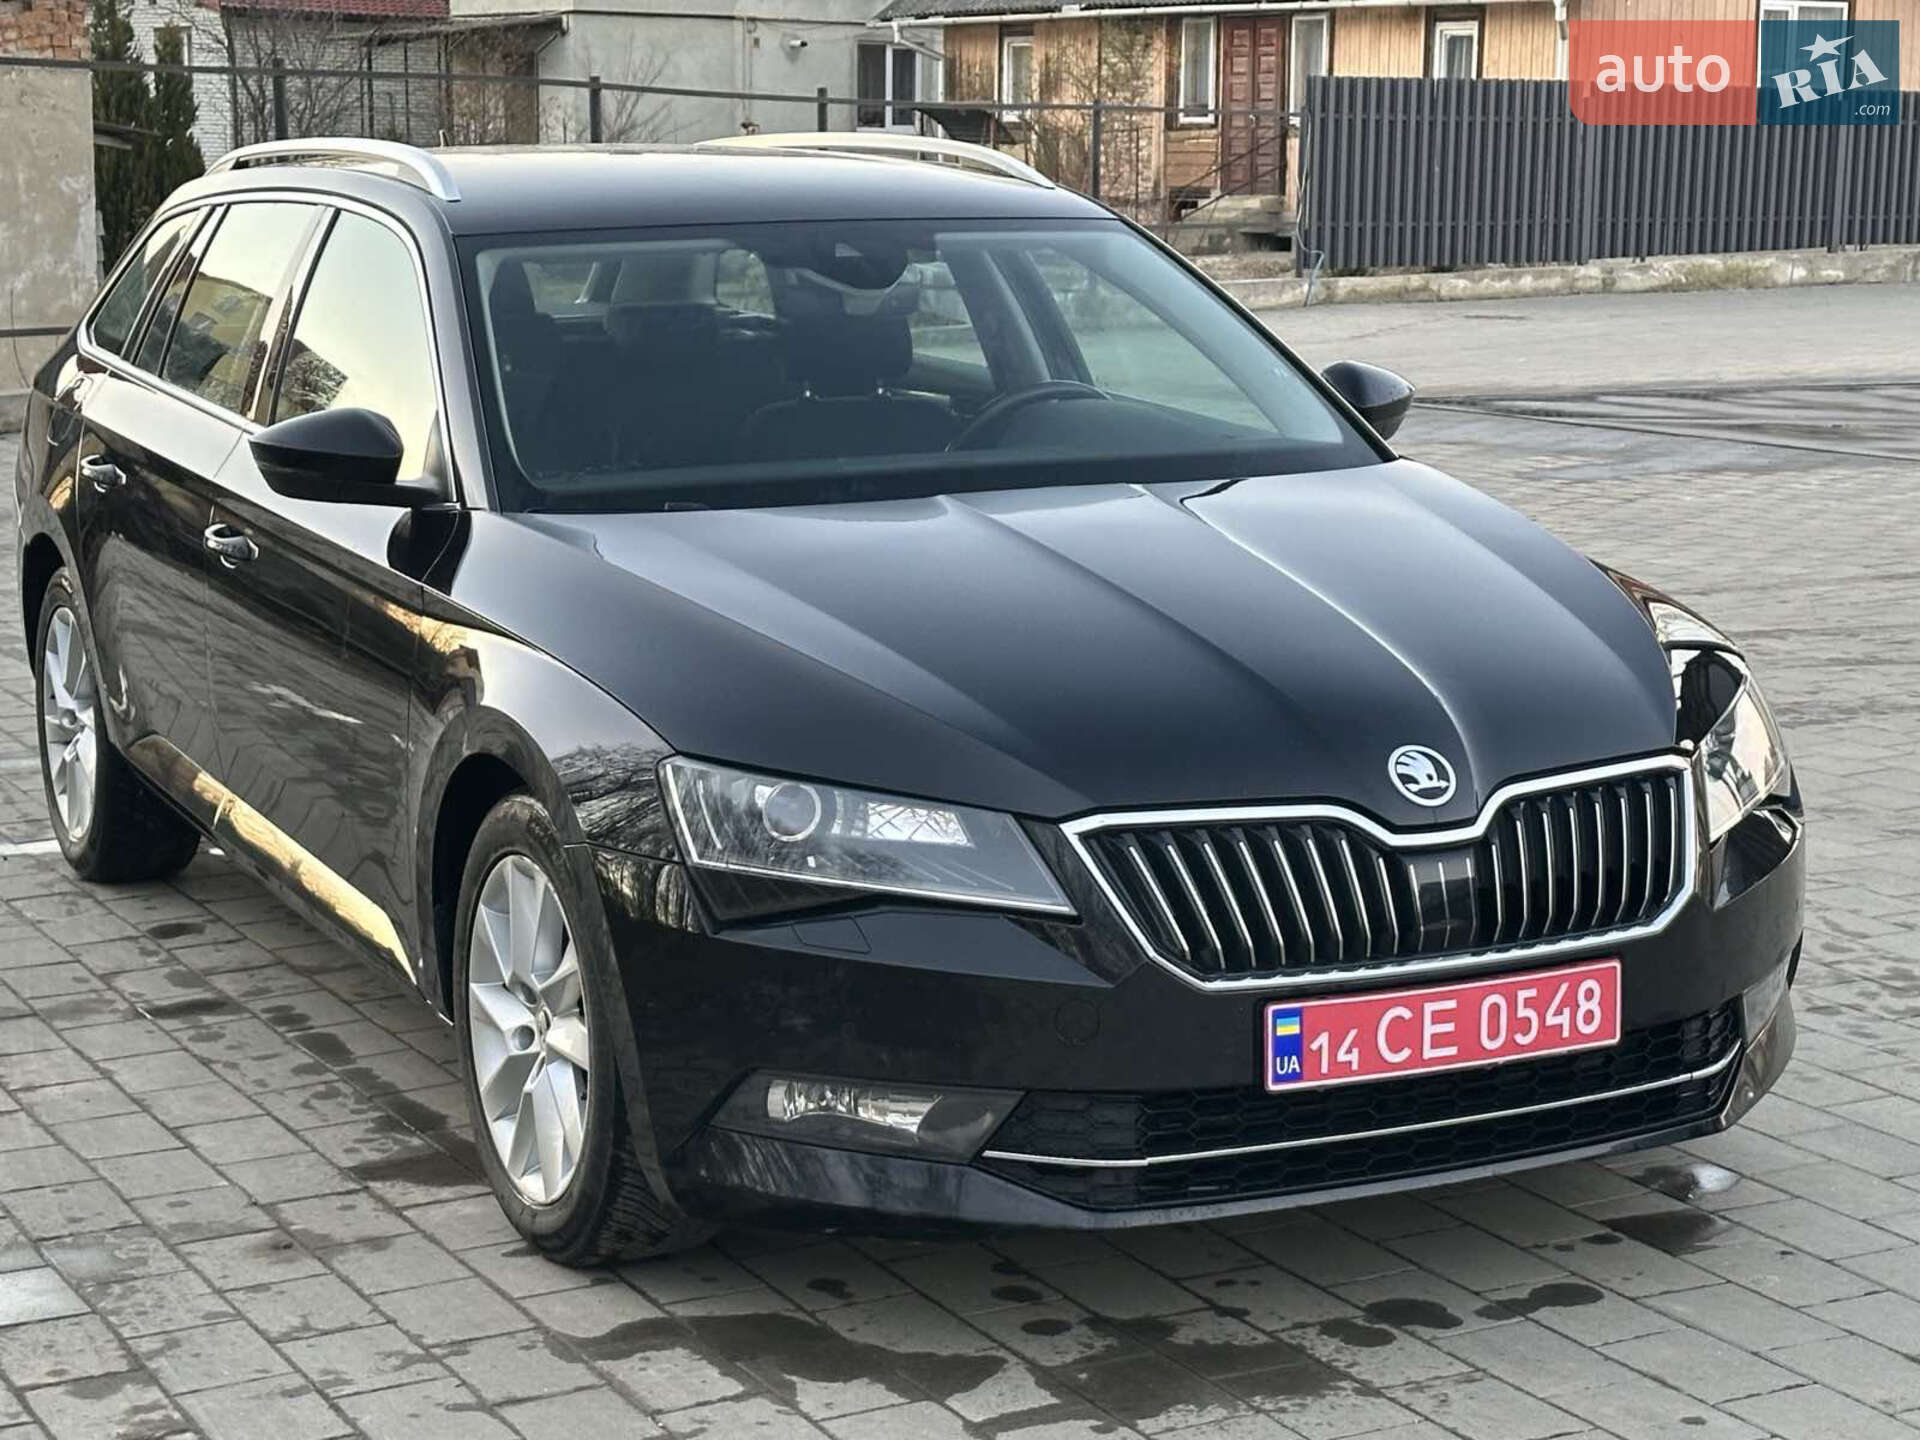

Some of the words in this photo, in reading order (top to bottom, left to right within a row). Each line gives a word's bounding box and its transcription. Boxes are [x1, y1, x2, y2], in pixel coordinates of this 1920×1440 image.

[1309, 1028, 1359, 1074] 14
[1377, 999, 1458, 1063] CE
[1479, 978, 1602, 1051] 0548
[1276, 1056, 1300, 1075] UA
